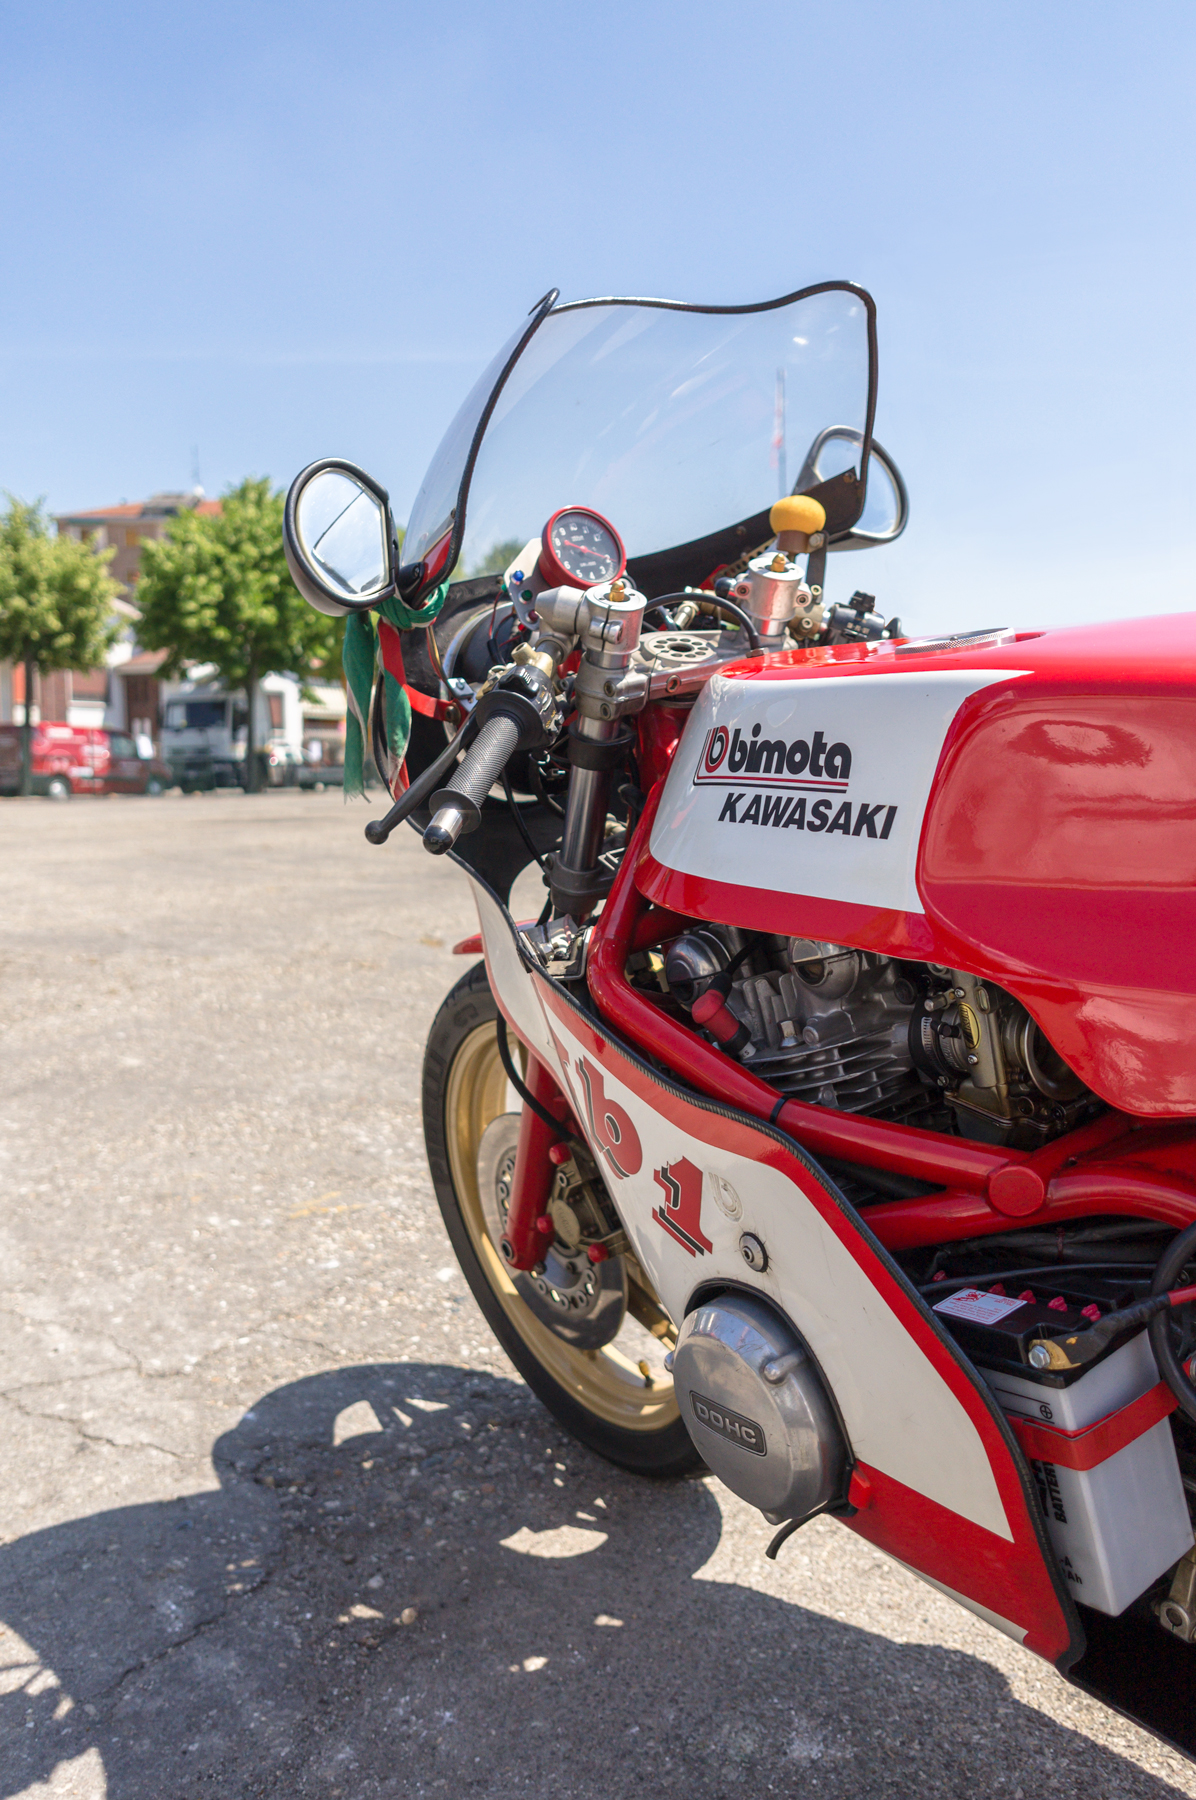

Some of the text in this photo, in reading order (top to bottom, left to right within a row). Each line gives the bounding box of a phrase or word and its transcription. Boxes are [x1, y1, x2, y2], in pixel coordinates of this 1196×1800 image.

[559, 527, 566, 536] 9
[555, 538, 561, 546] 8
[556, 550, 561, 558] 7
[564, 561, 571, 569] 6
[576, 570, 583, 578] 5
[600, 566, 606, 574] 3
[727, 722, 852, 780] bimota
[718, 792, 899, 840] KAWASAKI
[695, 1402, 757, 1444] DOHC
